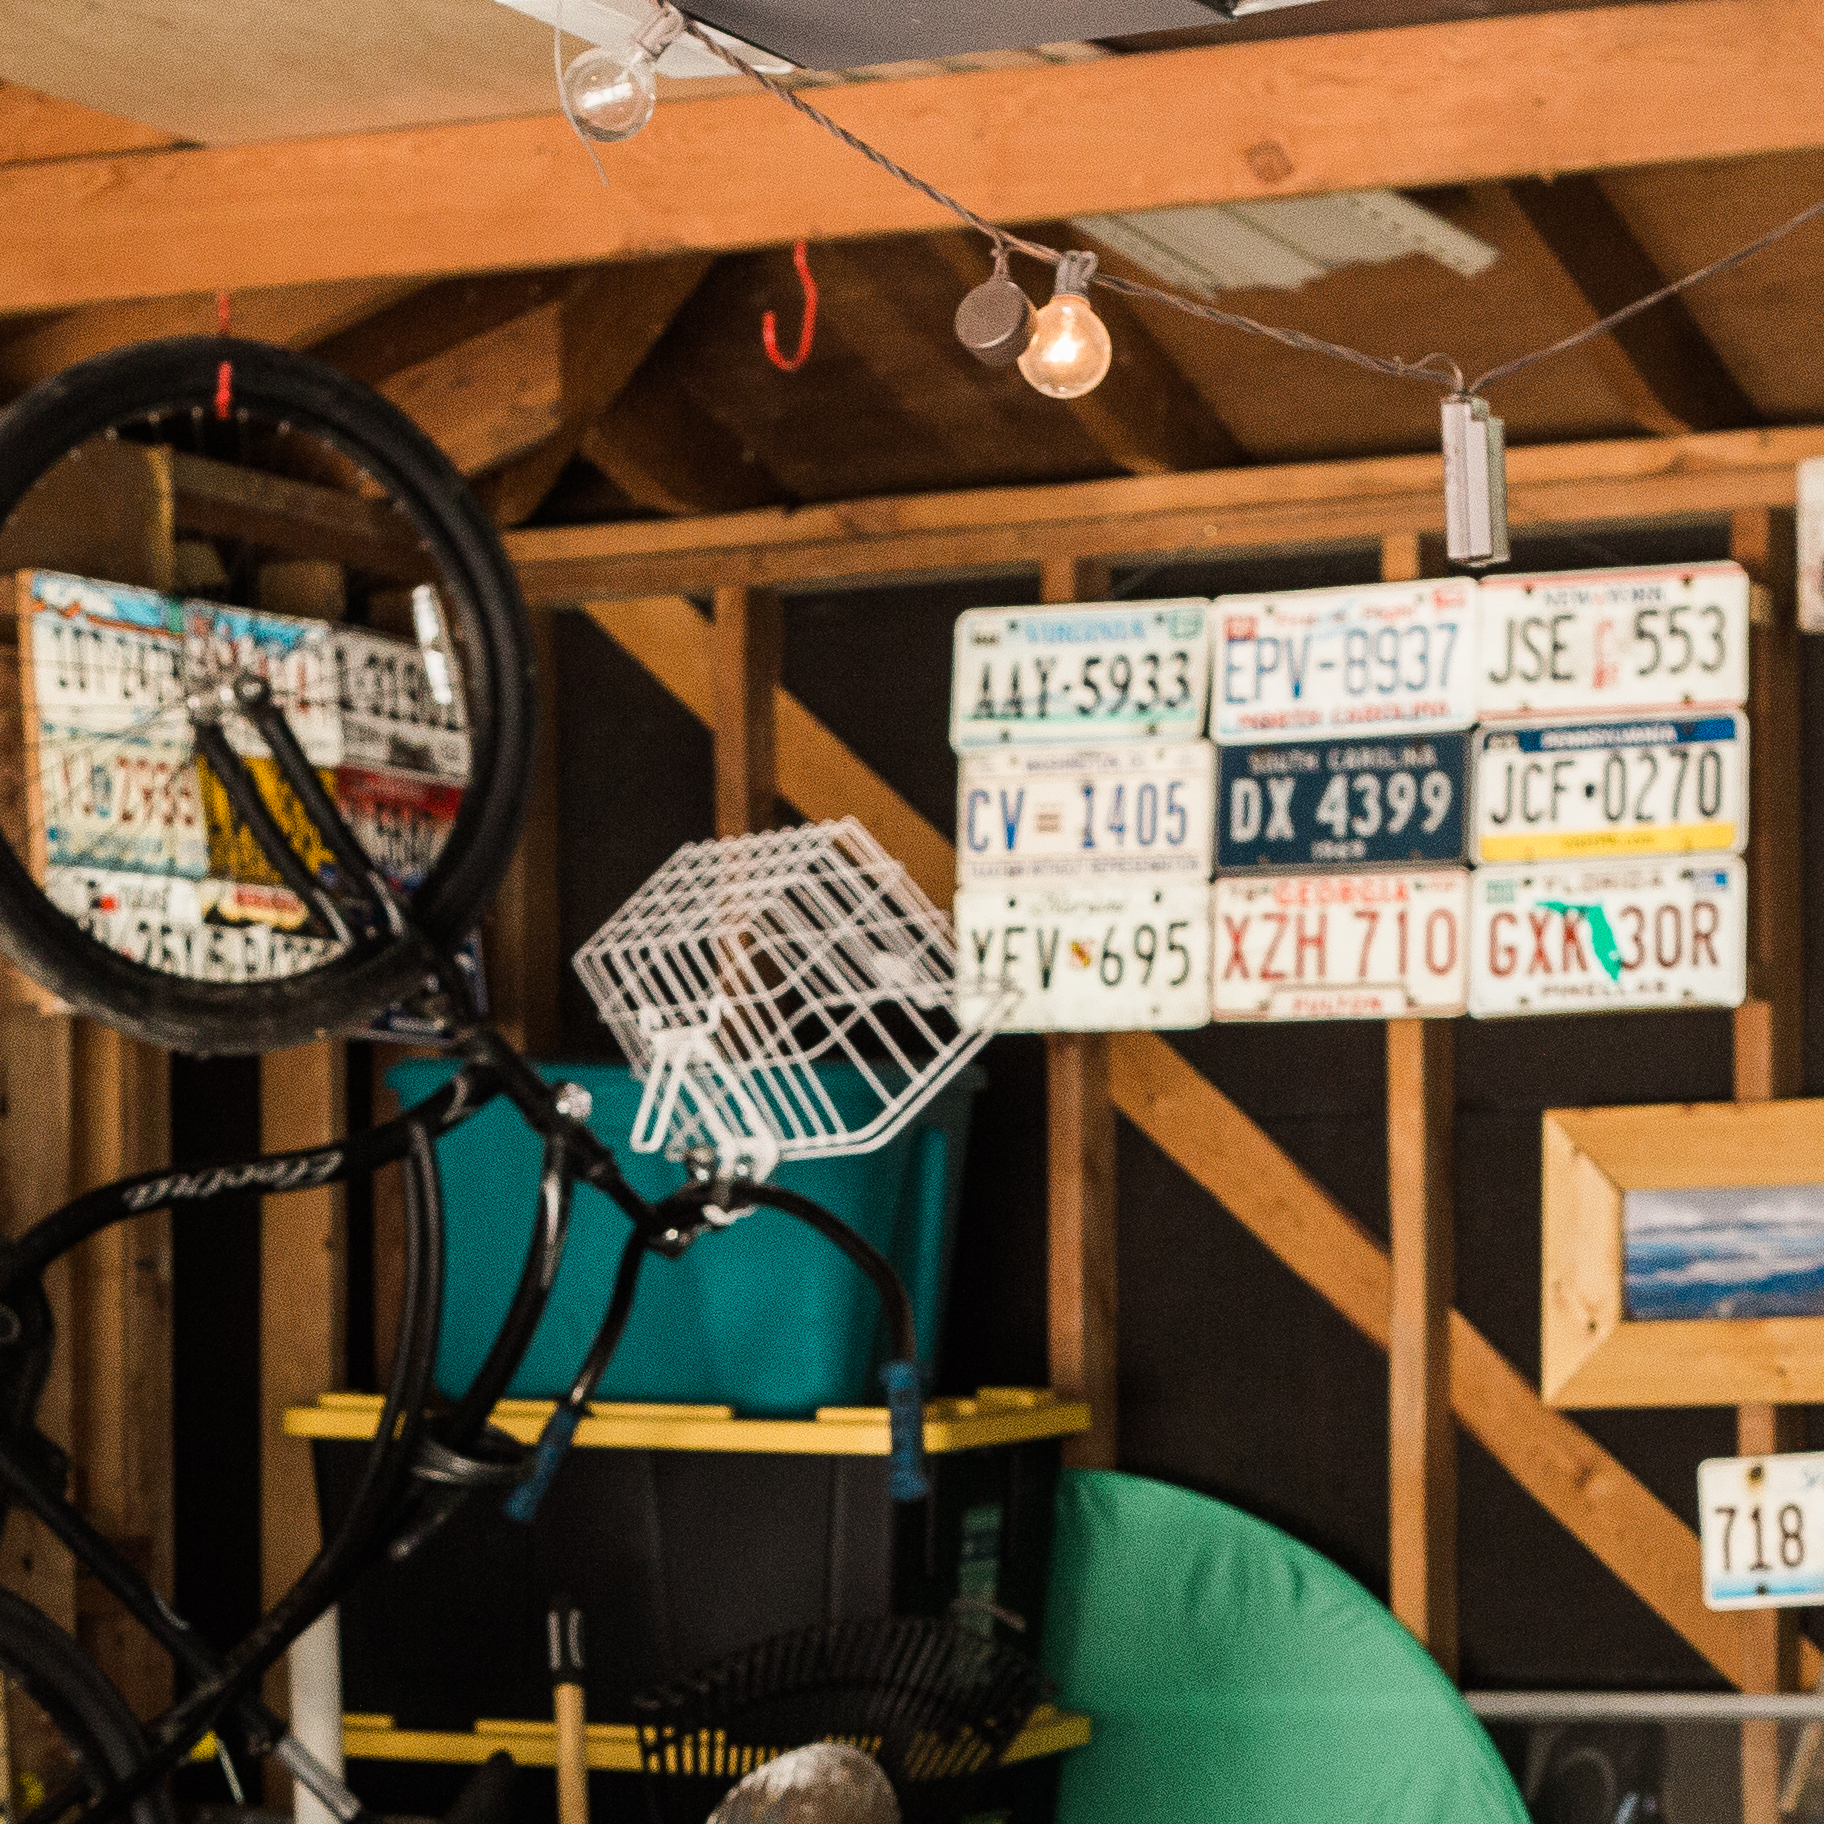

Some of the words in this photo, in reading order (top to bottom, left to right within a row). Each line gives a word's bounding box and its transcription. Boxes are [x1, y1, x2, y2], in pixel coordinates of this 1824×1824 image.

[1488, 611, 1577, 684] JSE
[1634, 604, 1727, 677] 553
[967, 787, 1026, 854] CV
[1082, 780, 1187, 850] 1405
[1230, 777, 1296, 843] DX
[1316, 770, 1454, 839] 4399
[1272, 879, 1409, 905] GEORGIA
[1099, 921, 1190, 987] 695
[1223, 911, 1327, 981] XZH
[1352, 908, 1458, 978] 710
[1714, 1502, 1807, 1575] 718
